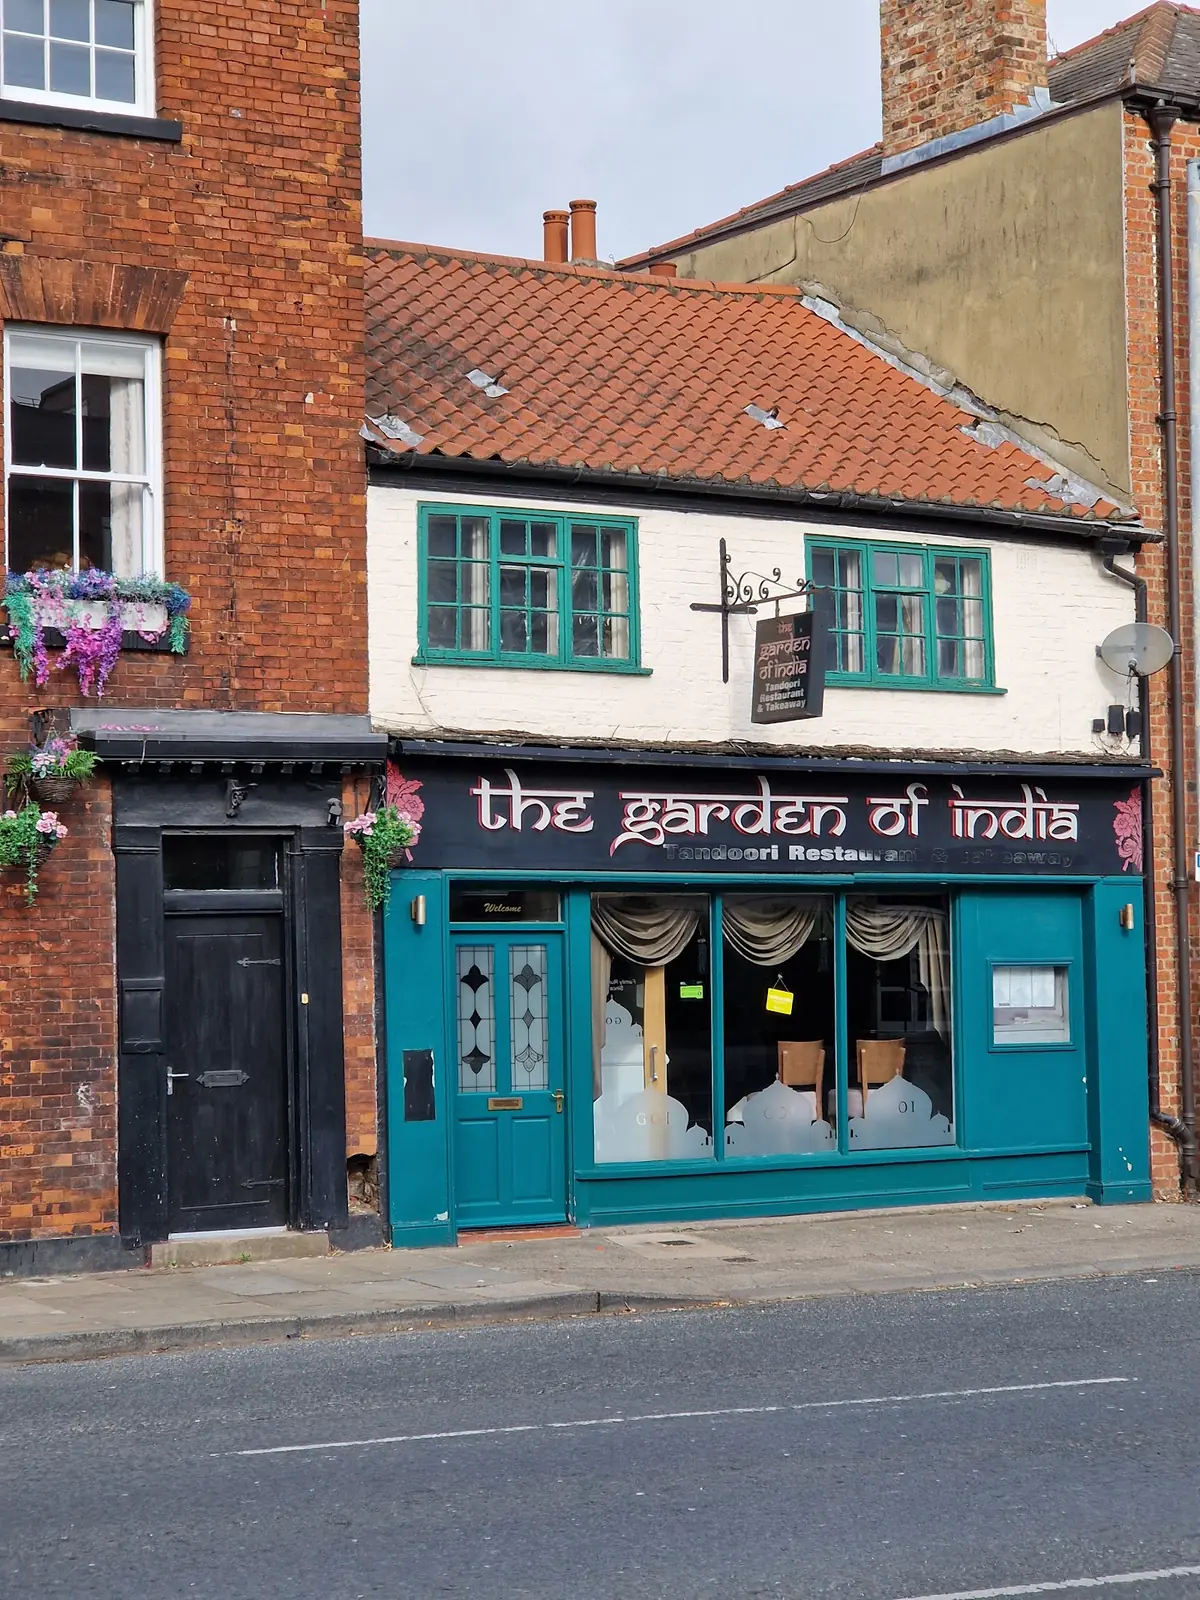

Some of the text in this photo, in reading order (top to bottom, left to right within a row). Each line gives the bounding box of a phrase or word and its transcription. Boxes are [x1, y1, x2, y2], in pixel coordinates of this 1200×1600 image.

[778, 621, 792, 633] the
[757, 633, 811, 665] garden
[759, 655, 807, 680] of india
[765, 678, 800, 692] Tandoori
[760, 688, 804, 703] Restaurant
[757, 699, 807, 713] & Takeaway
[469, 768, 1081, 857] the garden of india
[663, 844, 779, 861] Tandoori
[931, 847, 948, 863] &
[483, 902, 522, 913] Welcome
